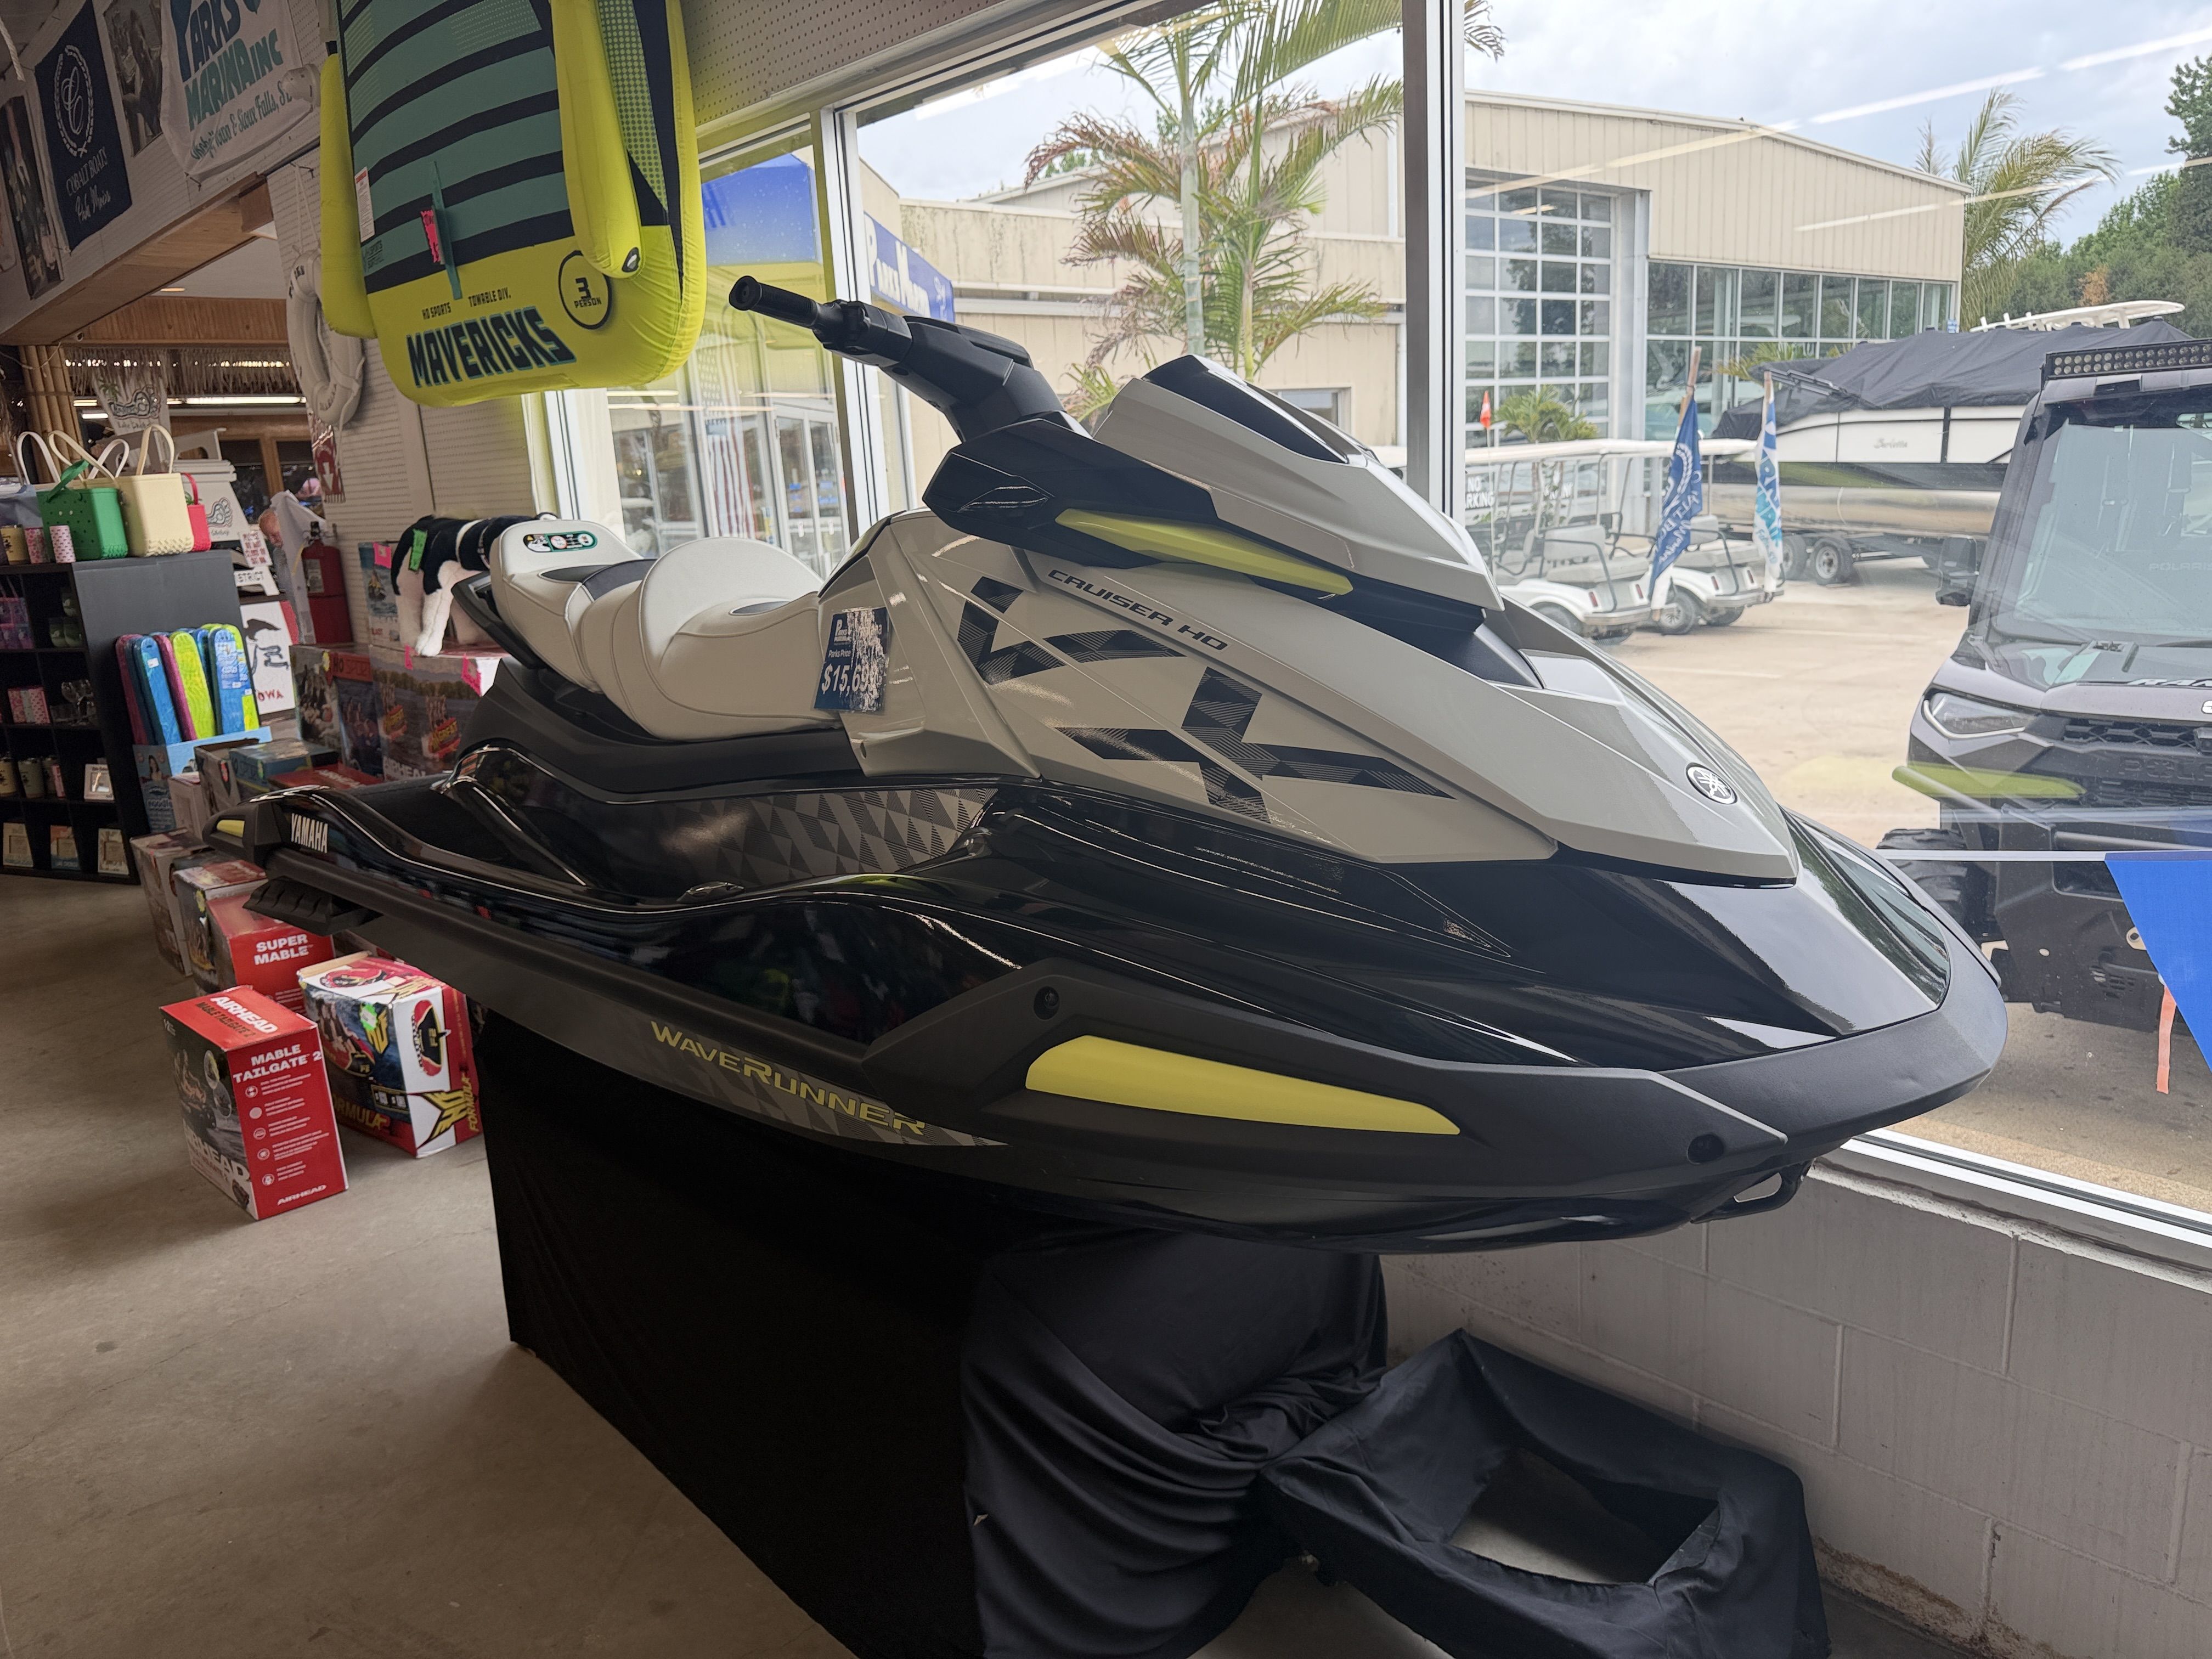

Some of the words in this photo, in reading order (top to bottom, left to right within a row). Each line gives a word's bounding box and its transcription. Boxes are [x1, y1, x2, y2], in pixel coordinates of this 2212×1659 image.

[468, 290, 497, 308] TOWABLE
[575, 277, 591, 300] 3
[430, 302, 452, 318] SPORTS
[574, 297, 602, 308] PERSON
[406, 306, 577, 388] MAVERICKS
[1467, 475, 1481, 493] NO
[1465, 490, 1496, 509] RKING
[1047, 569, 1173, 626] CRUISER
[1177, 624, 1228, 651] HO
[257, 689, 284, 702] OWA
[291, 812, 328, 854] YAMAHA
[256, 934, 308, 953] SUPER
[254, 945, 309, 966] MABLE
[210, 996, 278, 1034] AIRHEAD
[251, 1043, 301, 1067] MABLE
[233, 1055, 308, 1084] TAILGATE
[312, 1051, 323, 1062] 2
[651, 1021, 926, 1136] WAVERUNNER
[277, 1184, 327, 1206] AIRHEAD
